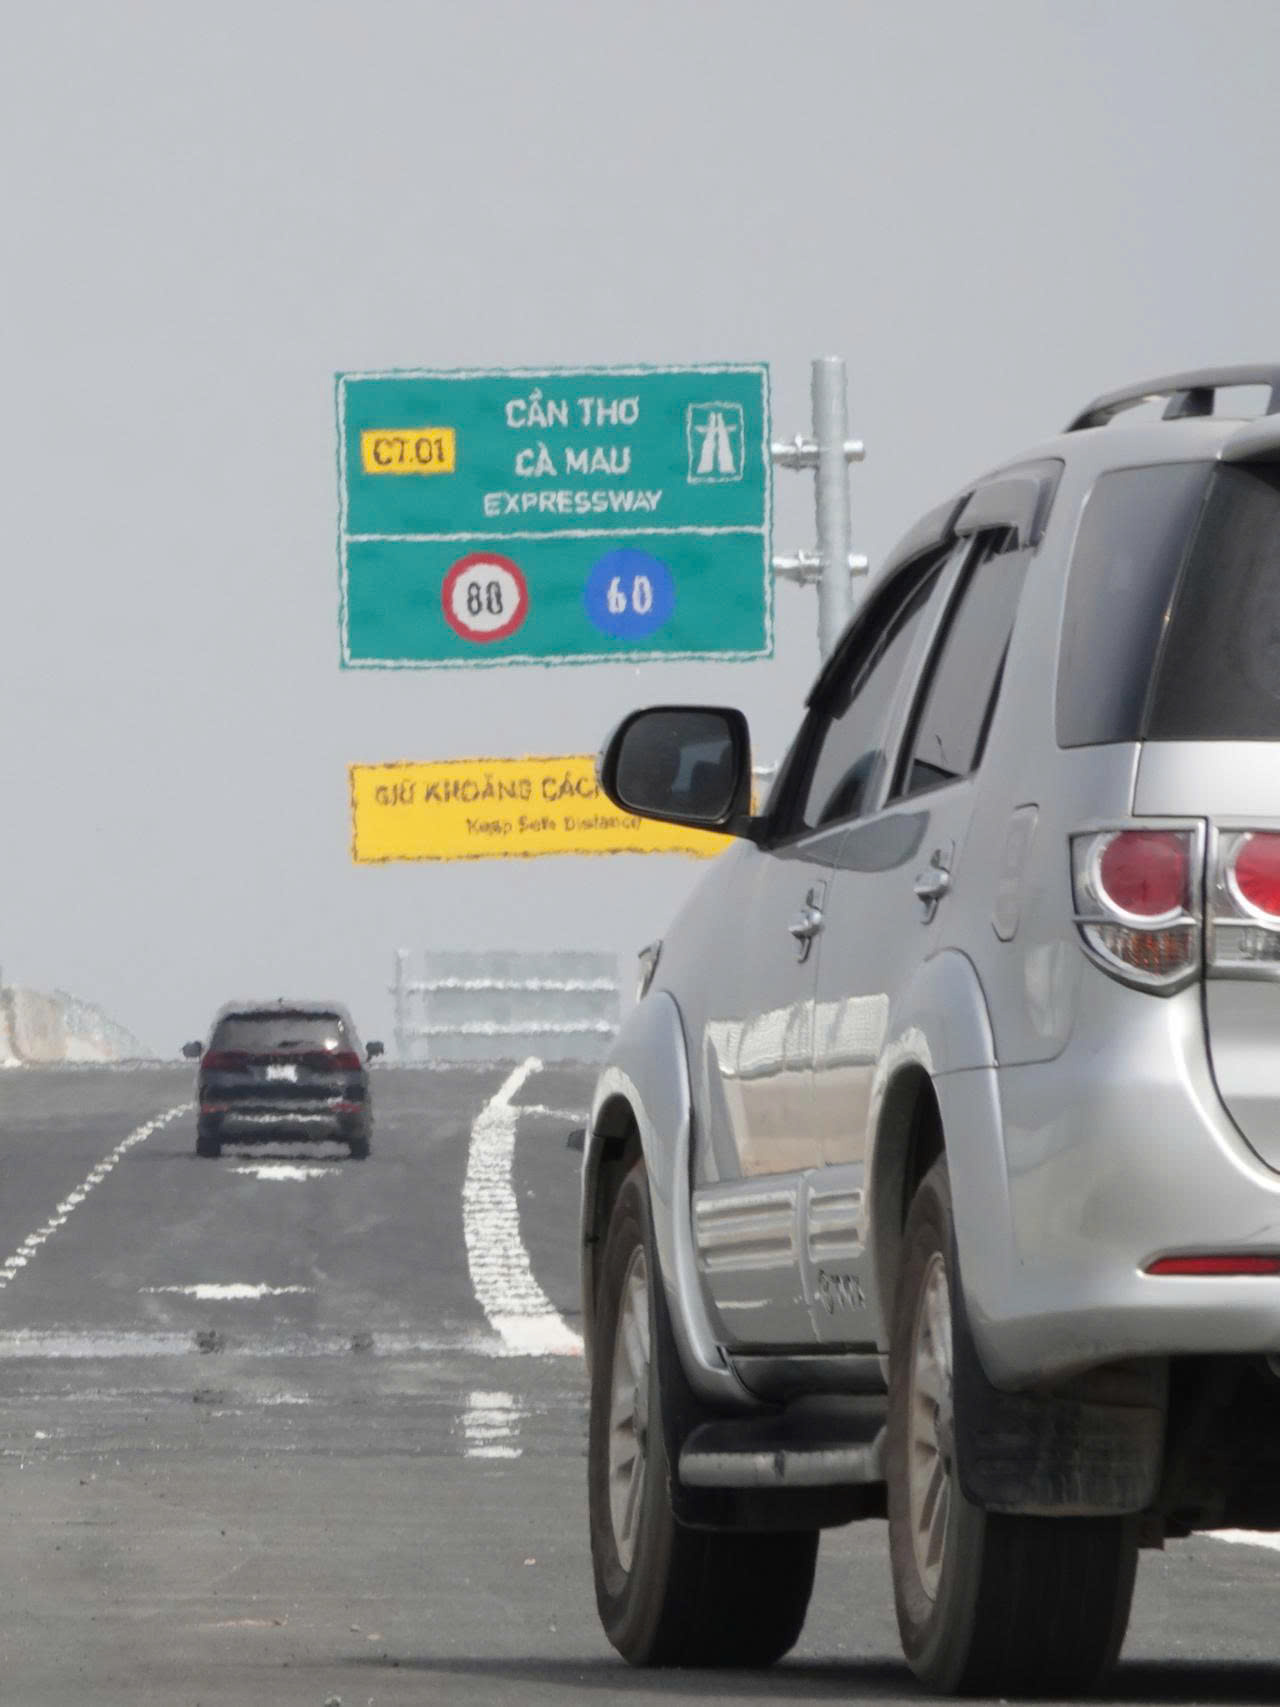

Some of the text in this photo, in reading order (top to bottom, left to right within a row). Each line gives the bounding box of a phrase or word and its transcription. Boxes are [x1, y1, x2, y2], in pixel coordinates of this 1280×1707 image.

[577, 395, 639, 426] THƠ
[373, 437, 445, 465] CT.01
[515, 441, 631, 476] CÀ MAU
[483, 490, 662, 517] EXPRESSWAY
[607, 576, 653, 614] 60
[542, 771, 599, 802] CÁC
